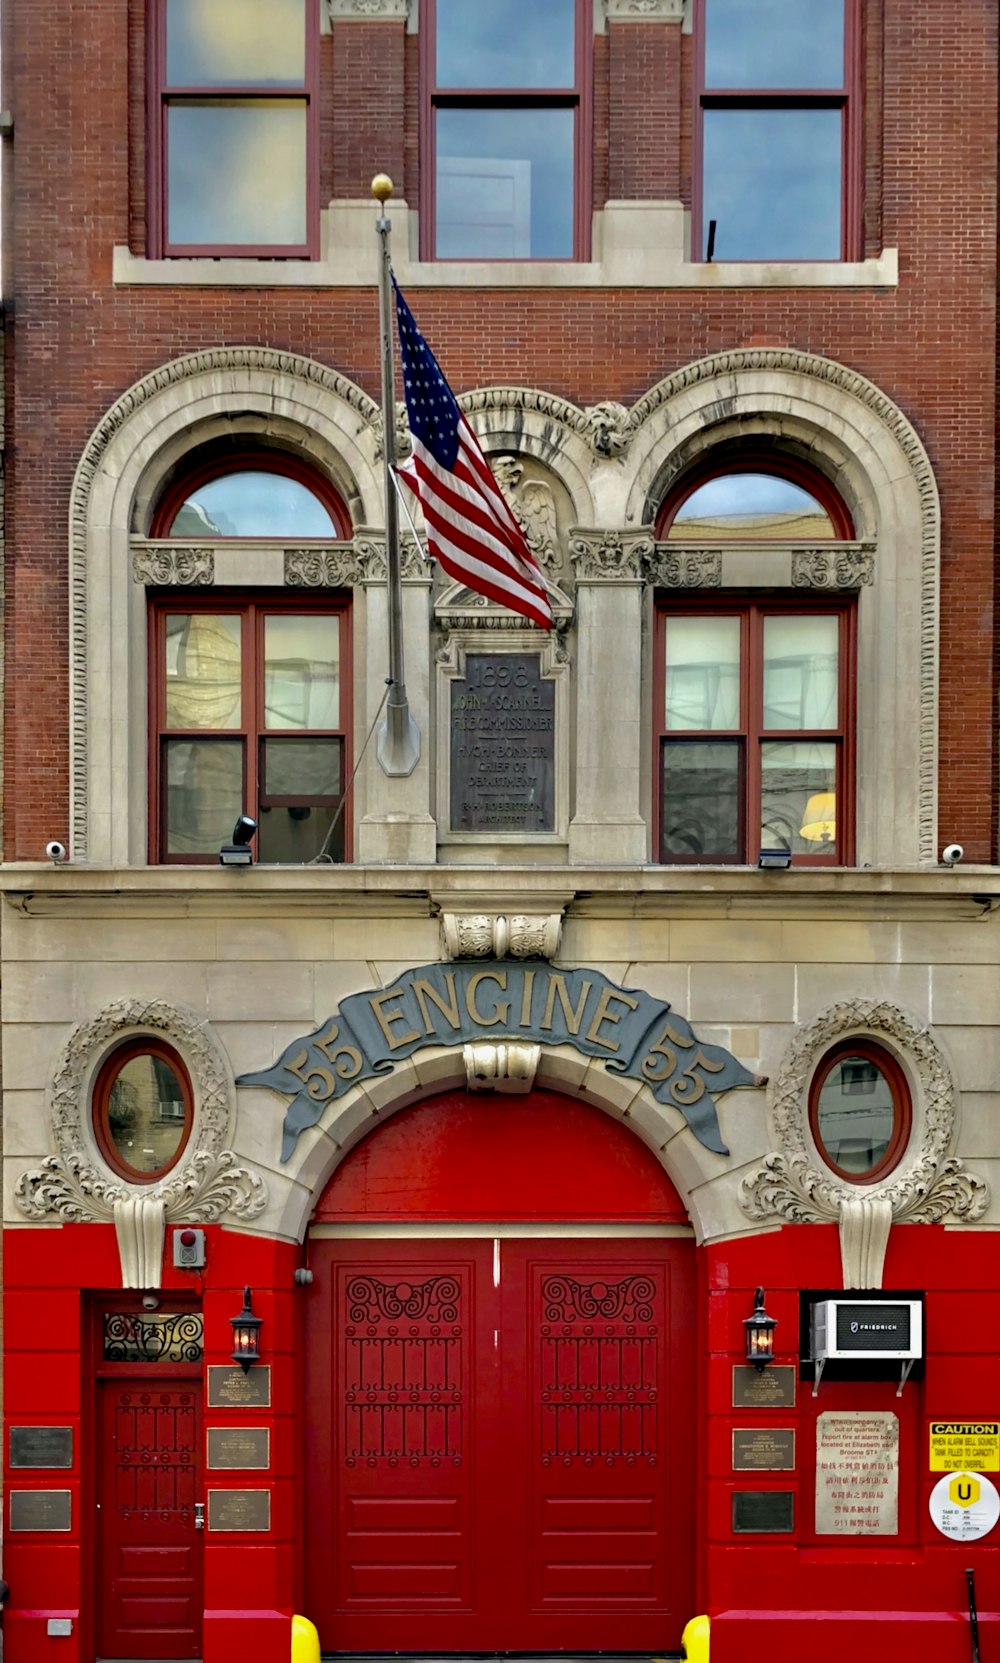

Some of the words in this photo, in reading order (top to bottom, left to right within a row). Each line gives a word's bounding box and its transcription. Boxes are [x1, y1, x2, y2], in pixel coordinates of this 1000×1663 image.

[475, 666, 530, 689] 1898
[475, 717, 553, 732] COMMISSIONER
[496, 746, 549, 759] BONNER
[478, 762, 510, 773] CHIEF
[513, 762, 528, 773] OF
[467, 776, 538, 788] DEPARTMENT
[283, 1023, 364, 1102] 55
[368, 970, 640, 1053] ENGINE
[641, 1022, 725, 1105] 55
[934, 1425, 995, 1434] CAUTION
[932, 1438, 946, 1446] WHEN
[947, 1438, 963, 1446] ALARM
[965, 1438, 976, 1446] BELL
[978, 1438, 998, 1446] SOUNDS
[934, 1448, 946, 1457] TANK
[947, 1448, 963, 1457] FILLED
[965, 1448, 971, 1457] TO
[972, 1448, 995, 1457] CAPACITY
[944, 1460, 951, 1468] DO
[952, 1460, 963, 1468] NOT
[963, 1460, 986, 1468] OVERFILL
[958, 1483, 971, 1500] U
